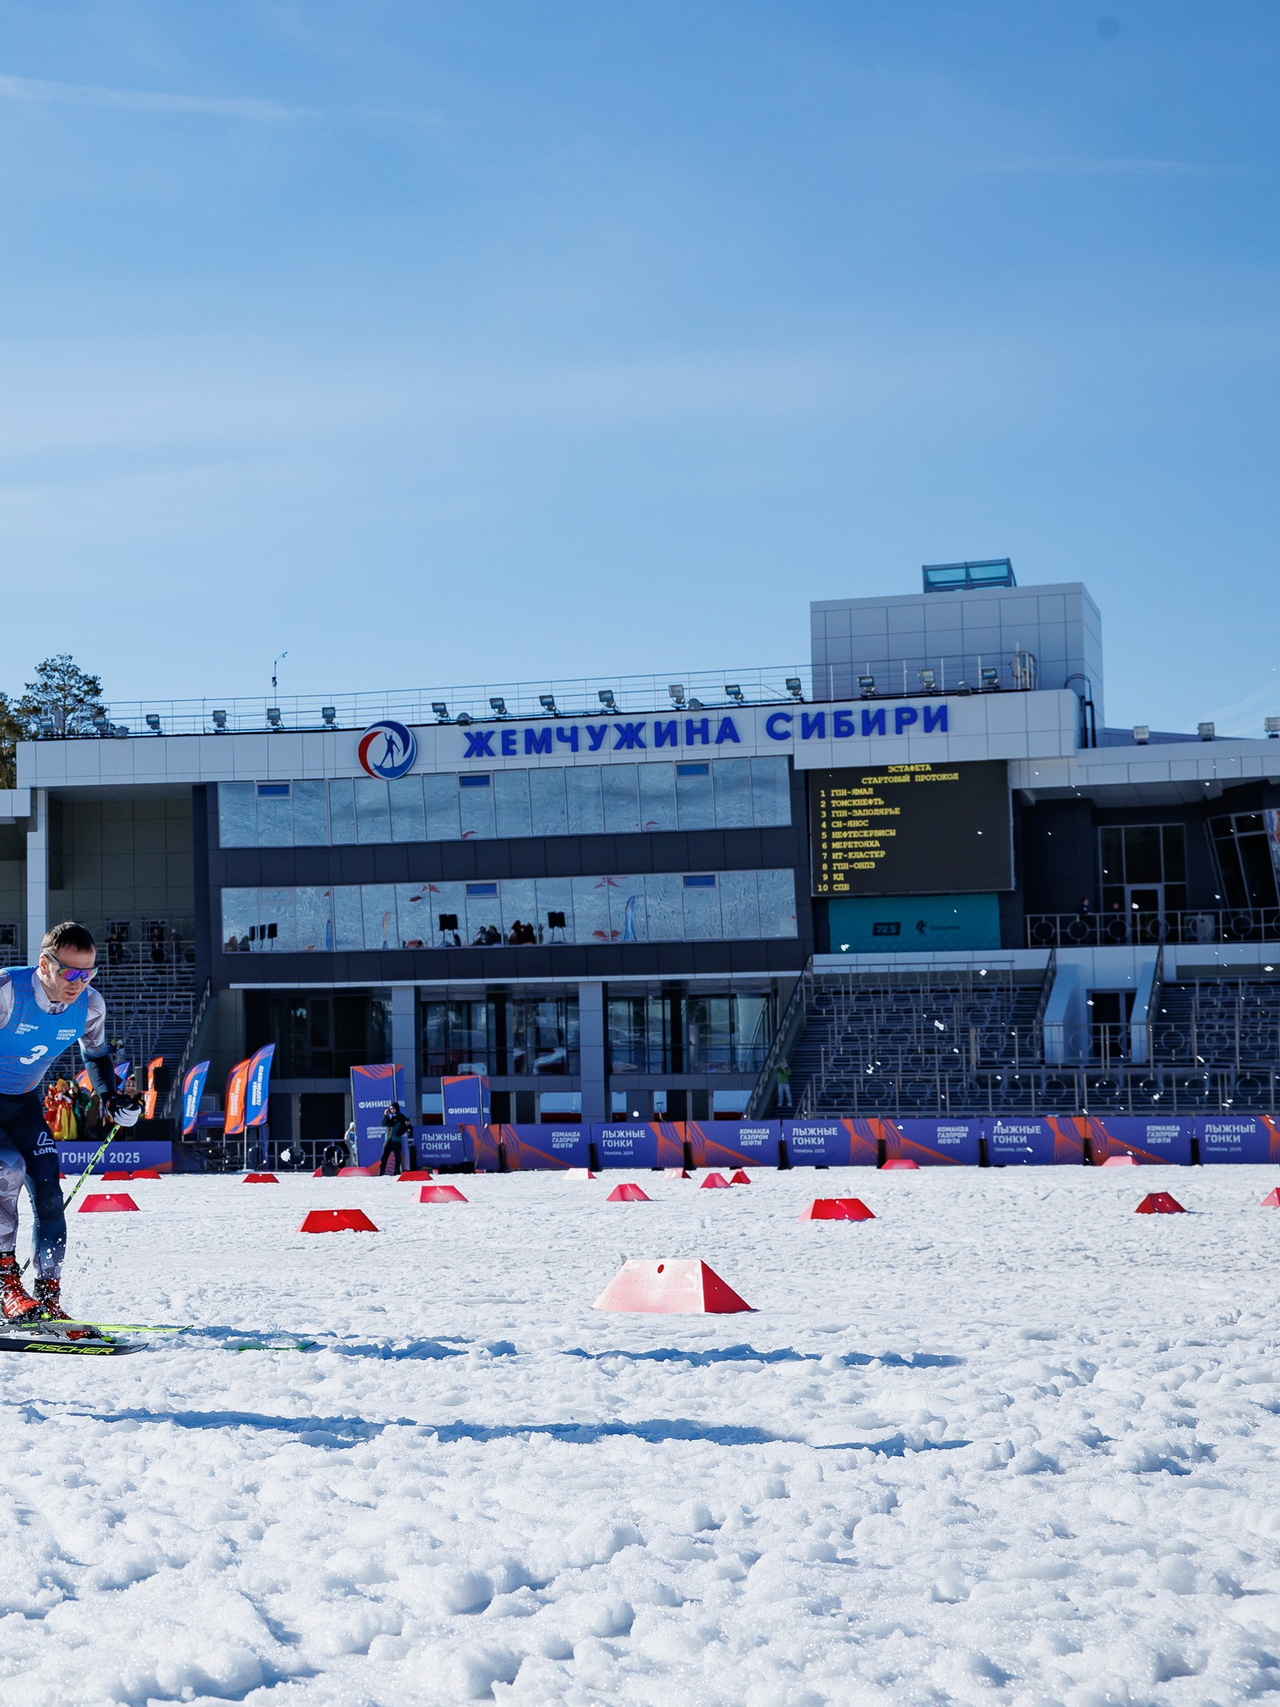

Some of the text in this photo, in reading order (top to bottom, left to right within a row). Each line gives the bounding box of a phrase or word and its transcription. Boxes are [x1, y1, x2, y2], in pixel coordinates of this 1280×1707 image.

[462, 704, 949, 758] ЖЕМЧУЖИНА СИБИРИ
[887, 764, 932, 773] ЭСТАФЕТА
[861, 772, 959, 785] СТАРТОВЫЙ ПРОТОКОЛ
[820, 789, 826, 797] 1
[820, 798, 885, 808] 2 ТОМСКНЕФТЬ
[821, 810, 827, 818] 3
[821, 821, 827, 829] 4
[831, 829, 896, 839] НЕФТЕСЕРВИСЫ
[822, 842, 827, 850] 6
[832, 850, 886, 860] ИТ-КЛАСТЕР
[822, 863, 828, 871] 8
[822, 873, 828, 881] 9
[817, 884, 828, 892] 10
[19, 1044, 49, 1065] 3
[358, 1099, 392, 1109] ФИНИШ
[447, 1106, 478, 1115] ФИНИШ
[792, 1127, 838, 1136] ЛЫЖНЫЕ
[992, 1125, 1042, 1134] ЛЫЖНЫЕ
[1204, 1123, 1256, 1133] ЛЫЖНЫЕ
[421, 1132, 463, 1141] ЛЫЖНЫЕ
[602, 1130, 646, 1138] ЛЫЖНЫЕ
[1205, 1134, 1241, 1143] ГОНКИ
[602, 1139, 633, 1148] ГОНКИ
[792, 1137, 825, 1145] ГОНКИ
[992, 1135, 1027, 1144] ГОНКИ
[421, 1142, 451, 1150] ГОНКИ
[32, 1146, 59, 1156] Löffle
[109, 1152, 140, 1164] 2025
[23, 1343, 115, 1355] FISCHER
